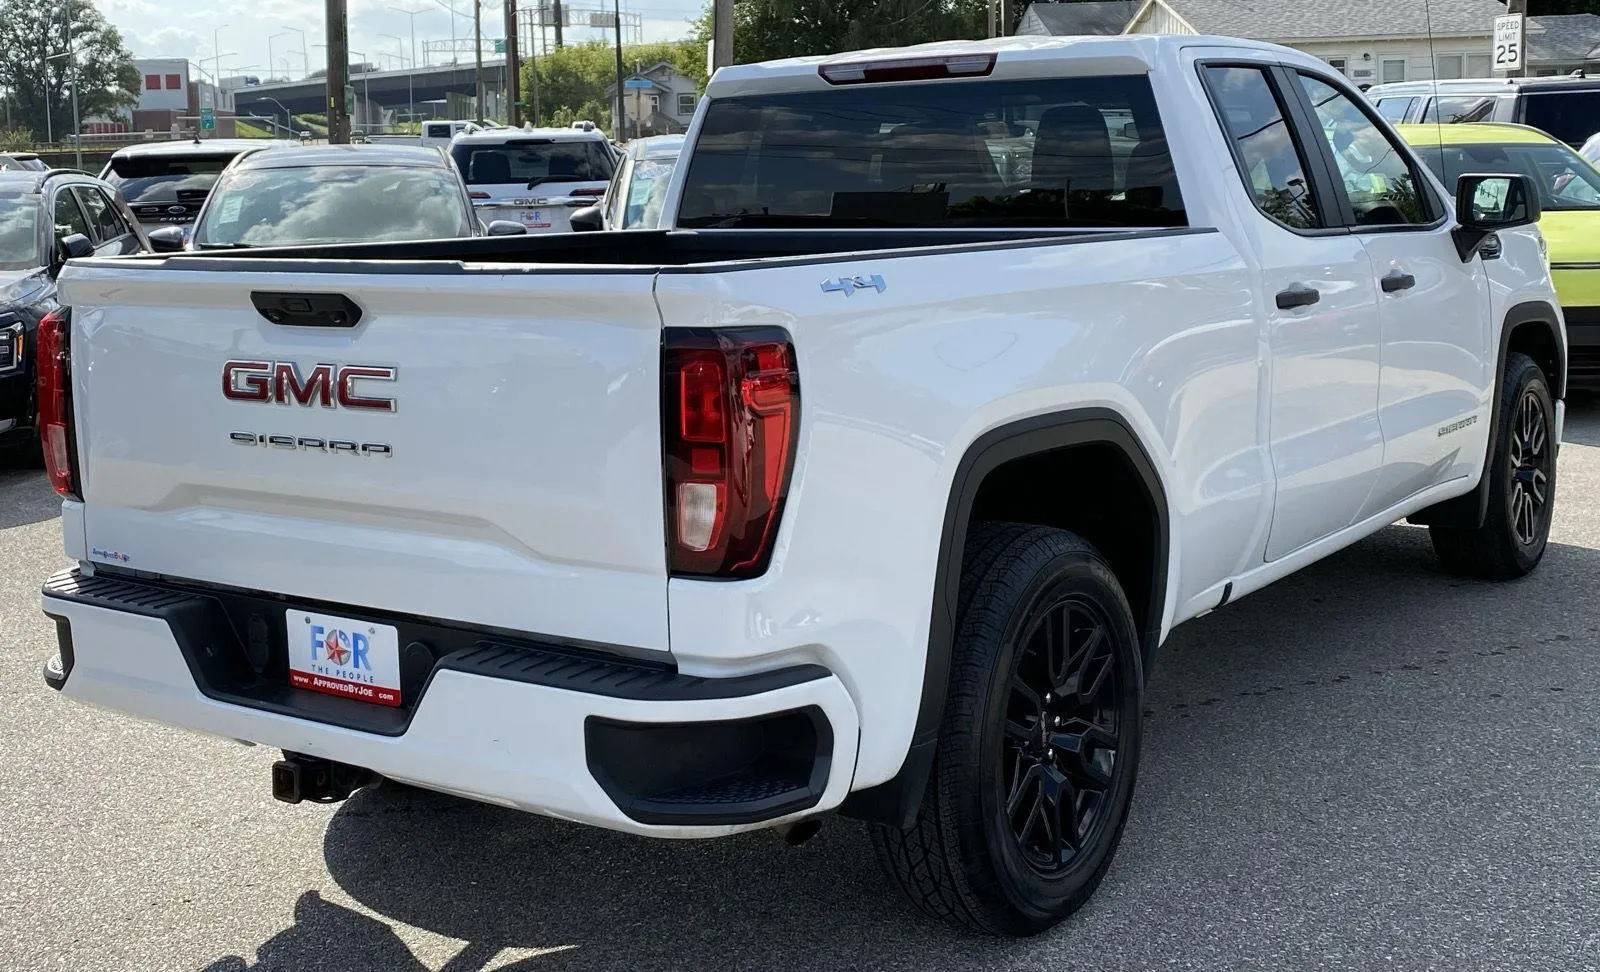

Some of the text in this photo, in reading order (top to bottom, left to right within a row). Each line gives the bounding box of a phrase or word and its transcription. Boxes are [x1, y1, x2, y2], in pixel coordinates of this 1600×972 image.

[1497, 21, 1519, 30] SPEED
[1498, 32, 1516, 42] LIMIT
[1497, 43, 1518, 64] 25
[222, 359, 398, 413] GMC
[229, 430, 393, 458] SIERRA
[310, 625, 372, 671] FOR
[311, 664, 374, 684] THE PEOPLE
